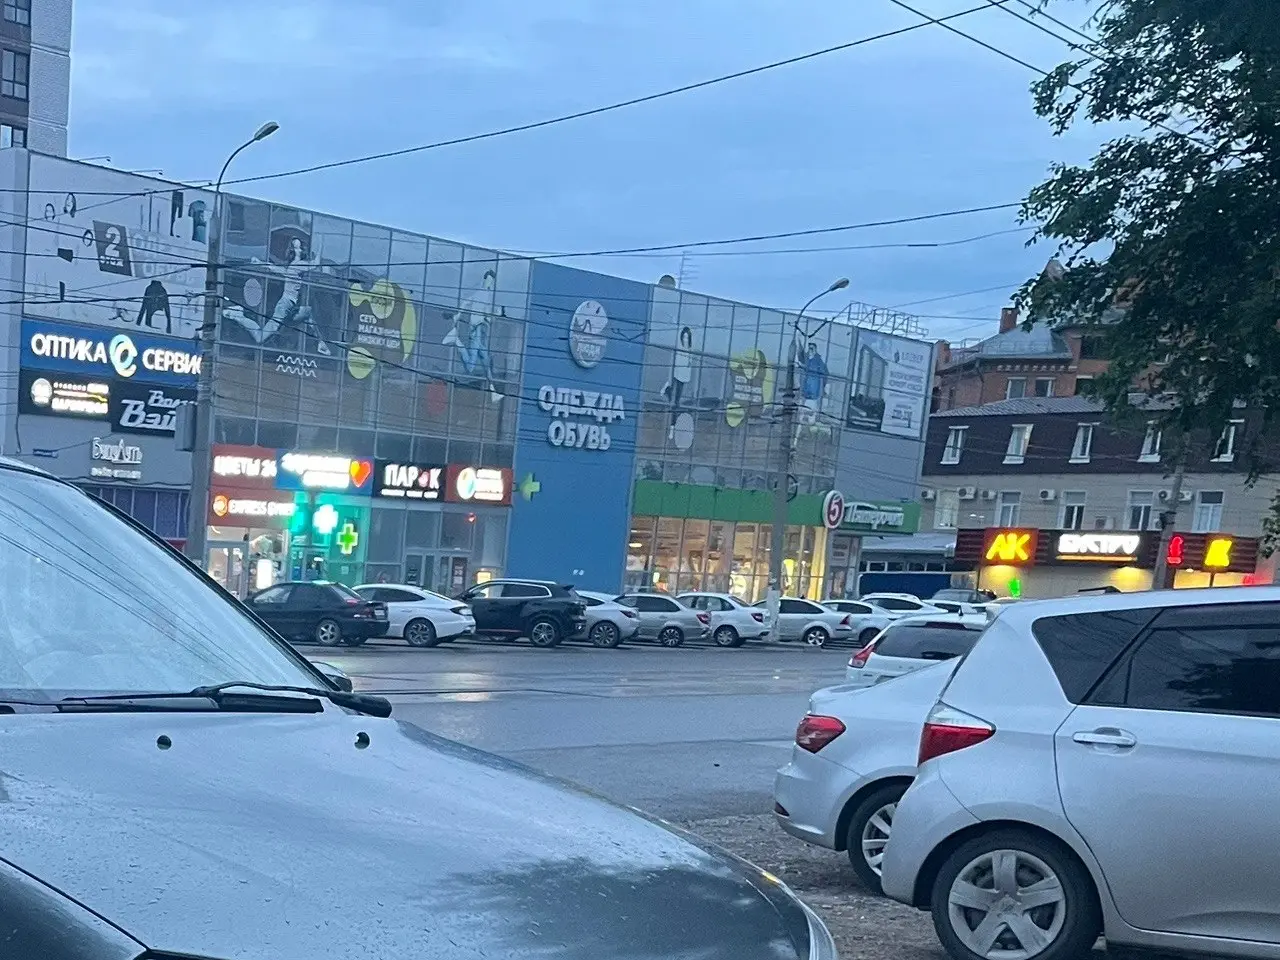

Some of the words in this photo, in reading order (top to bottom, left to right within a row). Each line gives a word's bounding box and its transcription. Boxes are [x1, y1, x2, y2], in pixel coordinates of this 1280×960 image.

[105, 227, 120, 257] 2
[359, 314, 377, 324] СЕТЬ
[31, 333, 107, 364] ОПТИКА
[538, 385, 625, 423] ОДЕЖДА
[548, 420, 611, 451] ОБУВЬ
[213, 455, 260, 476] ЦВЕТЫ
